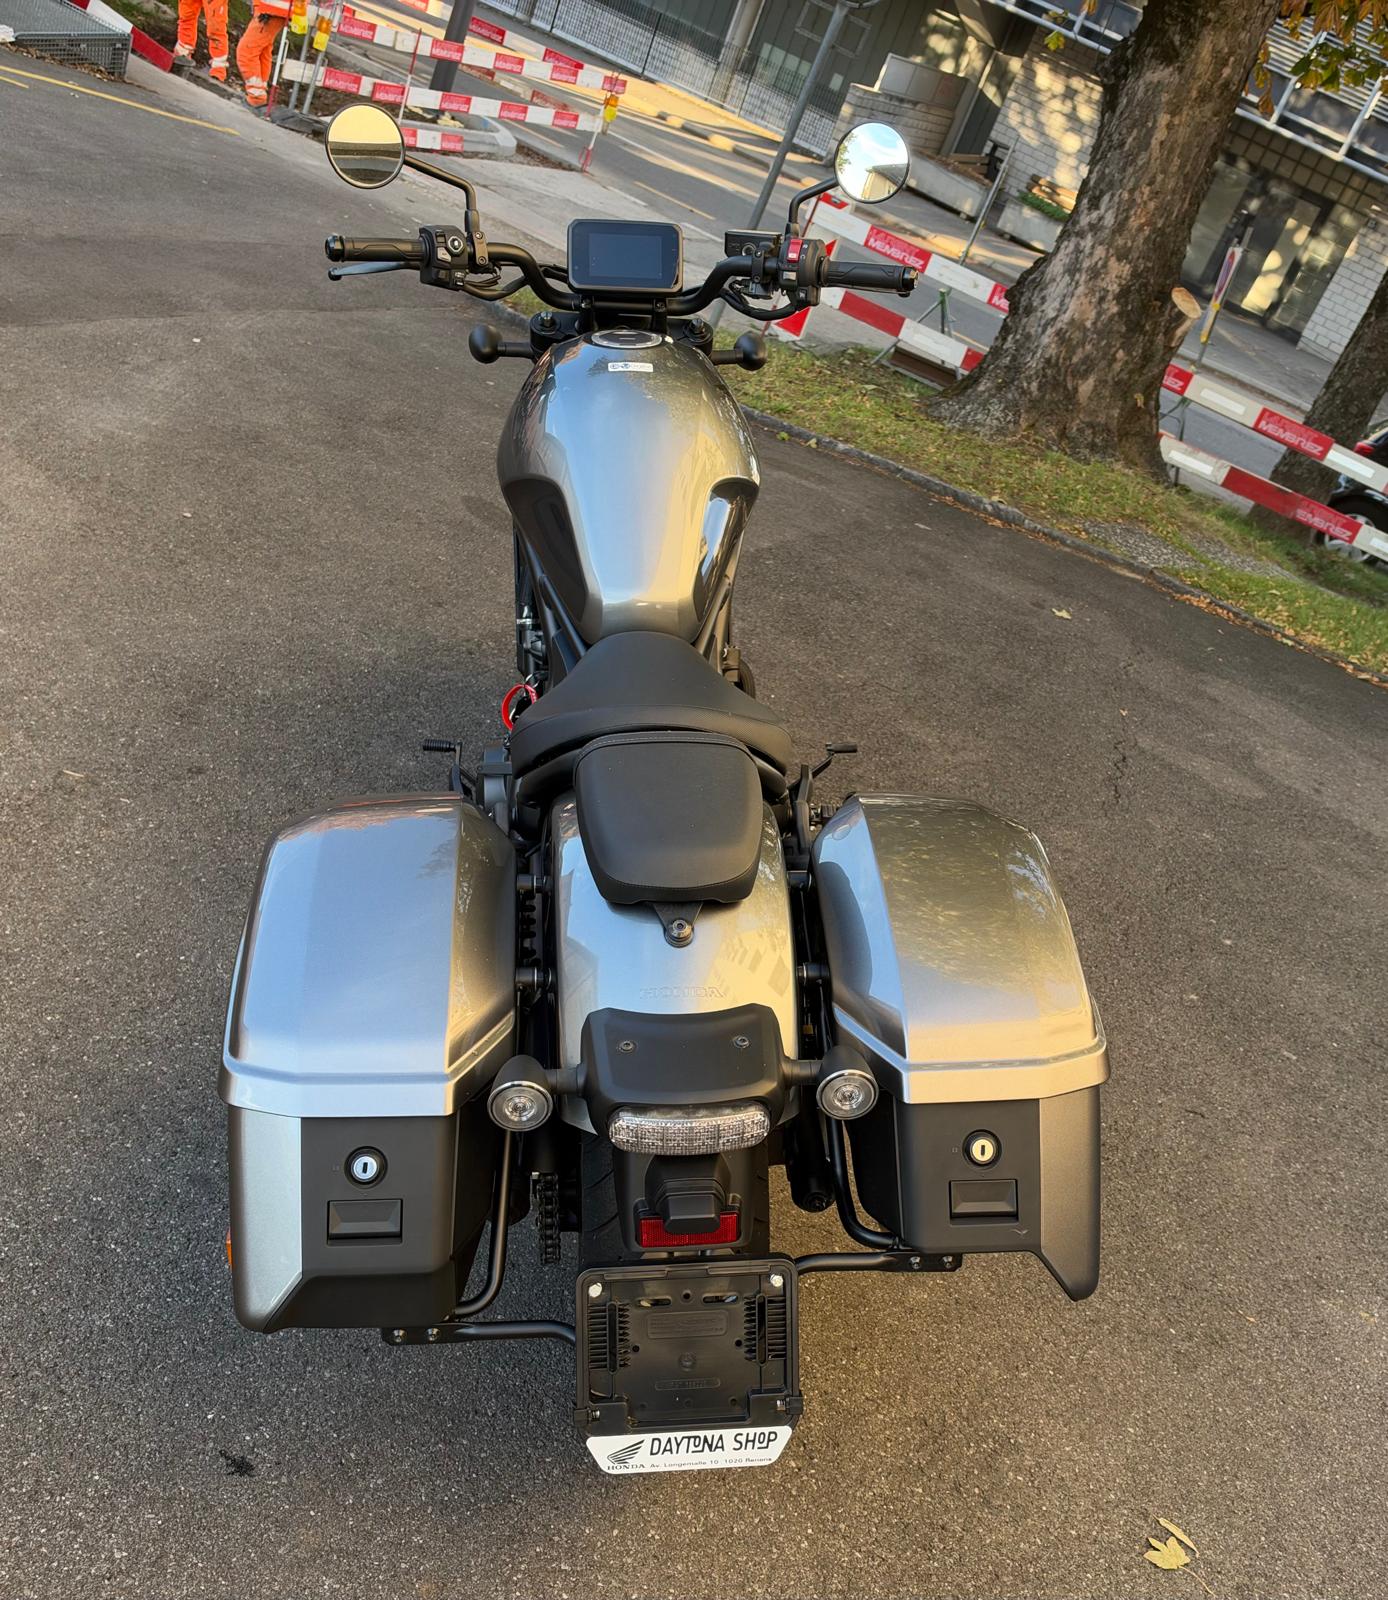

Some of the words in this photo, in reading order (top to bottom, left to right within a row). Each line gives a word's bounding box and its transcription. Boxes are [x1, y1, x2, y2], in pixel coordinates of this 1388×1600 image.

[868, 238, 925, 269] MEMBREZ
[1258, 421, 1324, 455] MEMBREZ
[1294, 508, 1353, 541] EMBREZ
[640, 986, 726, 1000] HONDA
[650, 1434, 724, 1455] DAYTONA
[733, 1431, 778, 1450] SHOP
[607, 1463, 645, 1471] HONDA
